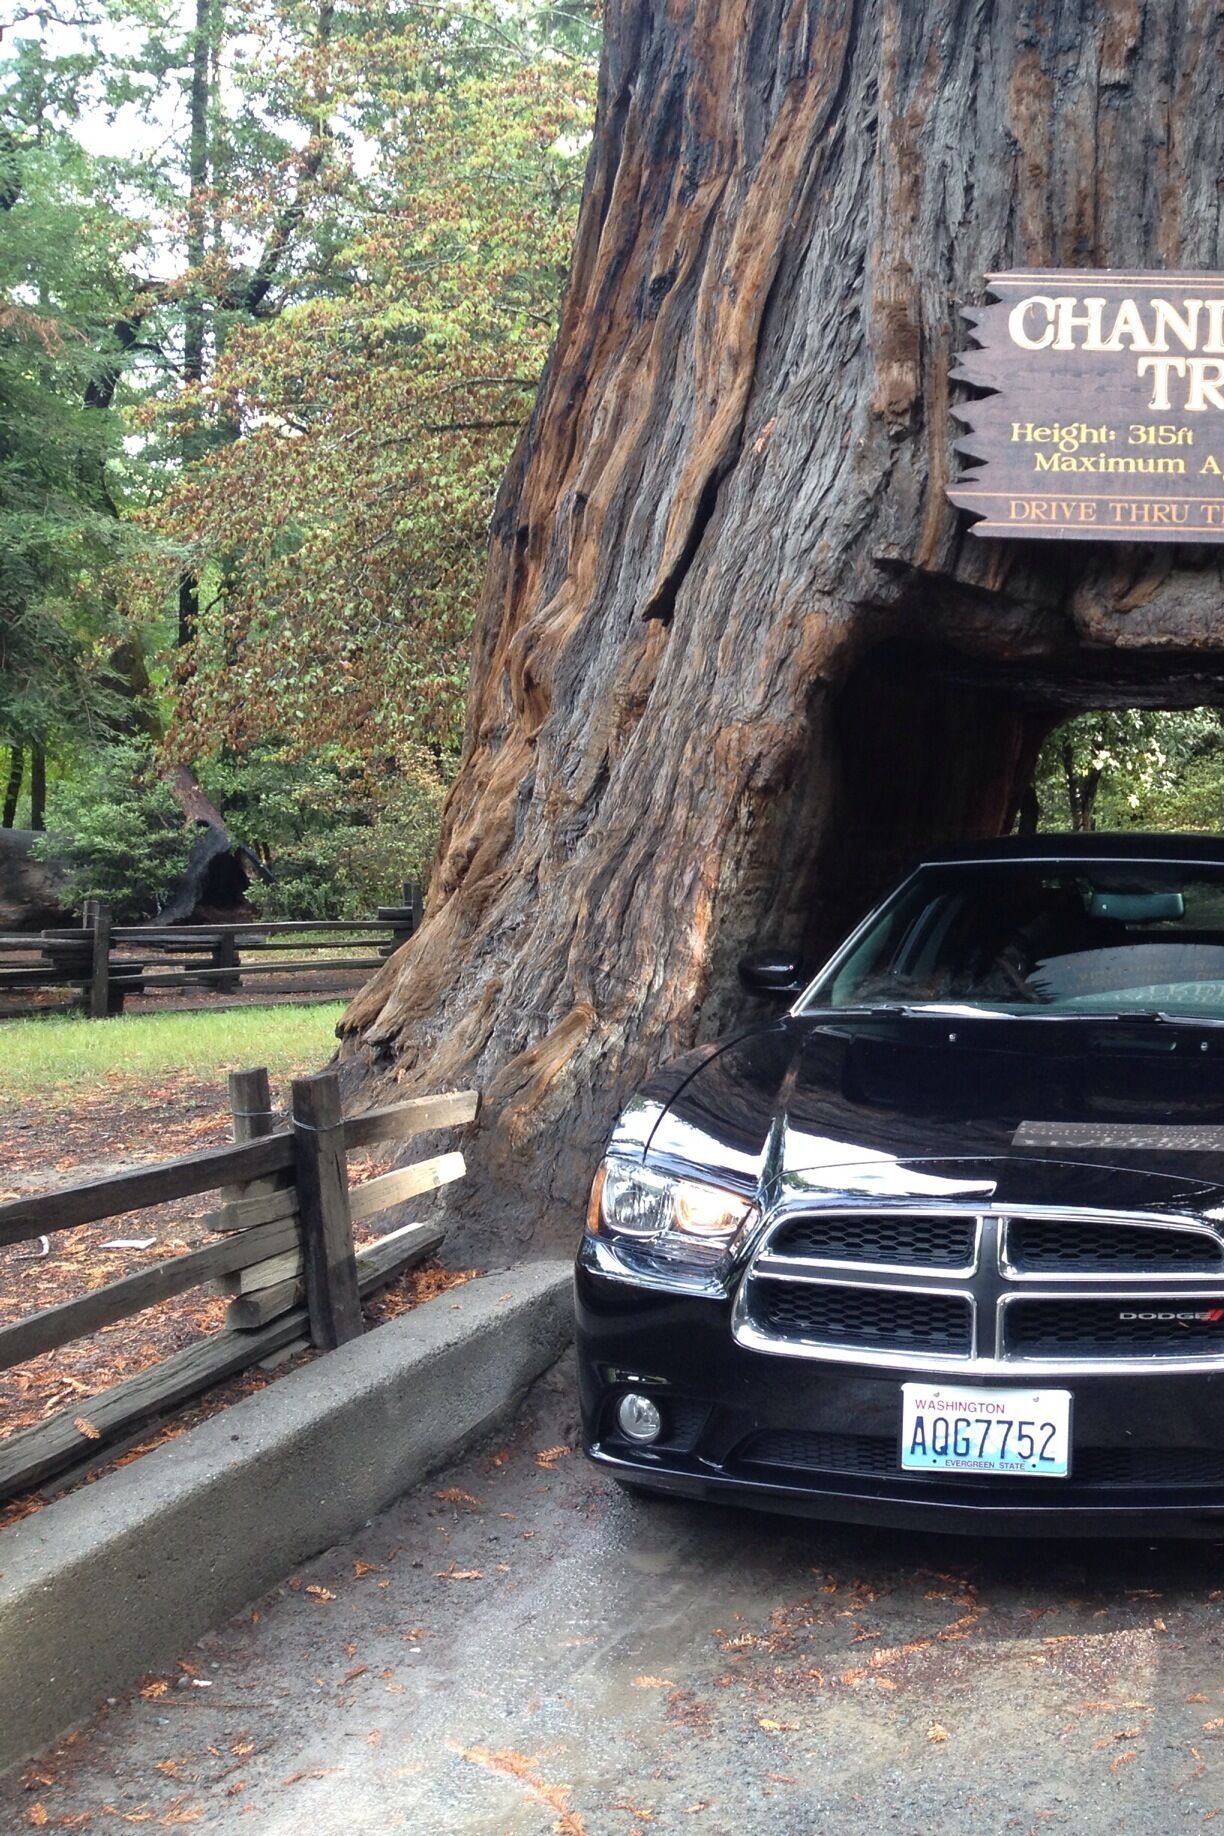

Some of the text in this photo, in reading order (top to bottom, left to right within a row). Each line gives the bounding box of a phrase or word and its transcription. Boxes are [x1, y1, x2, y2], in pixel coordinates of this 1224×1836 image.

[1010, 422, 1116, 453] Height:
[1128, 424, 1194, 445] 315ft
[1033, 452, 1185, 474] Maximum
[1010, 500, 1096, 521] DRIVE
[1109, 503, 1189, 524] THRU
[1119, 1312, 1212, 1321] DODGE
[915, 1399, 1006, 1415] WASHINGTON
[910, 1415, 1057, 1463] AQG7752
[945, 1459, 1026, 1471] EVERGREEN STATE
